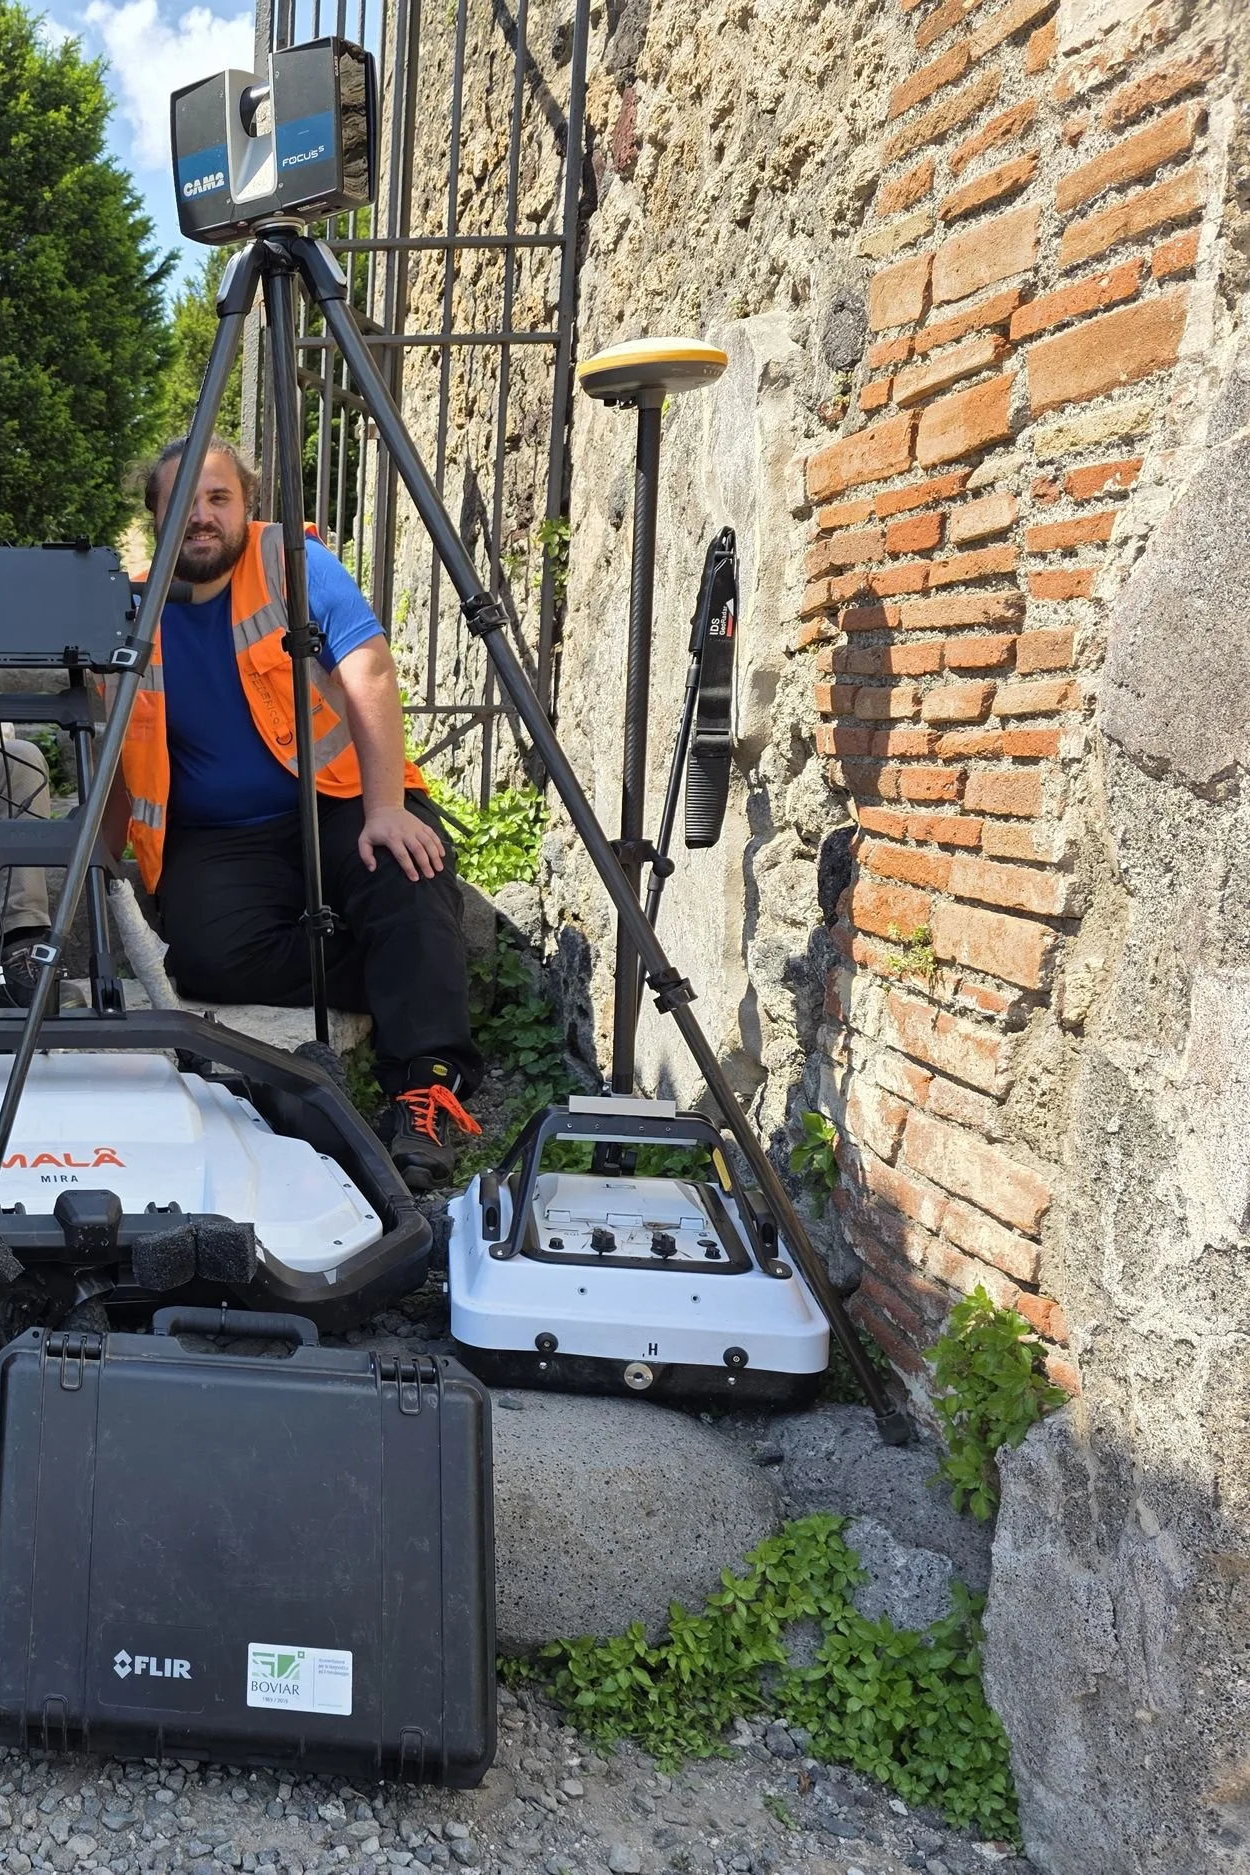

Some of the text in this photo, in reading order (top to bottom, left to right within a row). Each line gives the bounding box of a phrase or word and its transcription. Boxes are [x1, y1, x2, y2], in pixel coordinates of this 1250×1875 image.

[183, 171, 225, 197] CAM2
[709, 617, 720, 636] IDS
[719, 605, 728, 636] GeoRadar
[40, 1174, 79, 1183] MIRA
[648, 1342, 658, 1356] H
[134, 1655, 192, 1680] FLIR
[251, 1680, 300, 1696] BOVIAR
